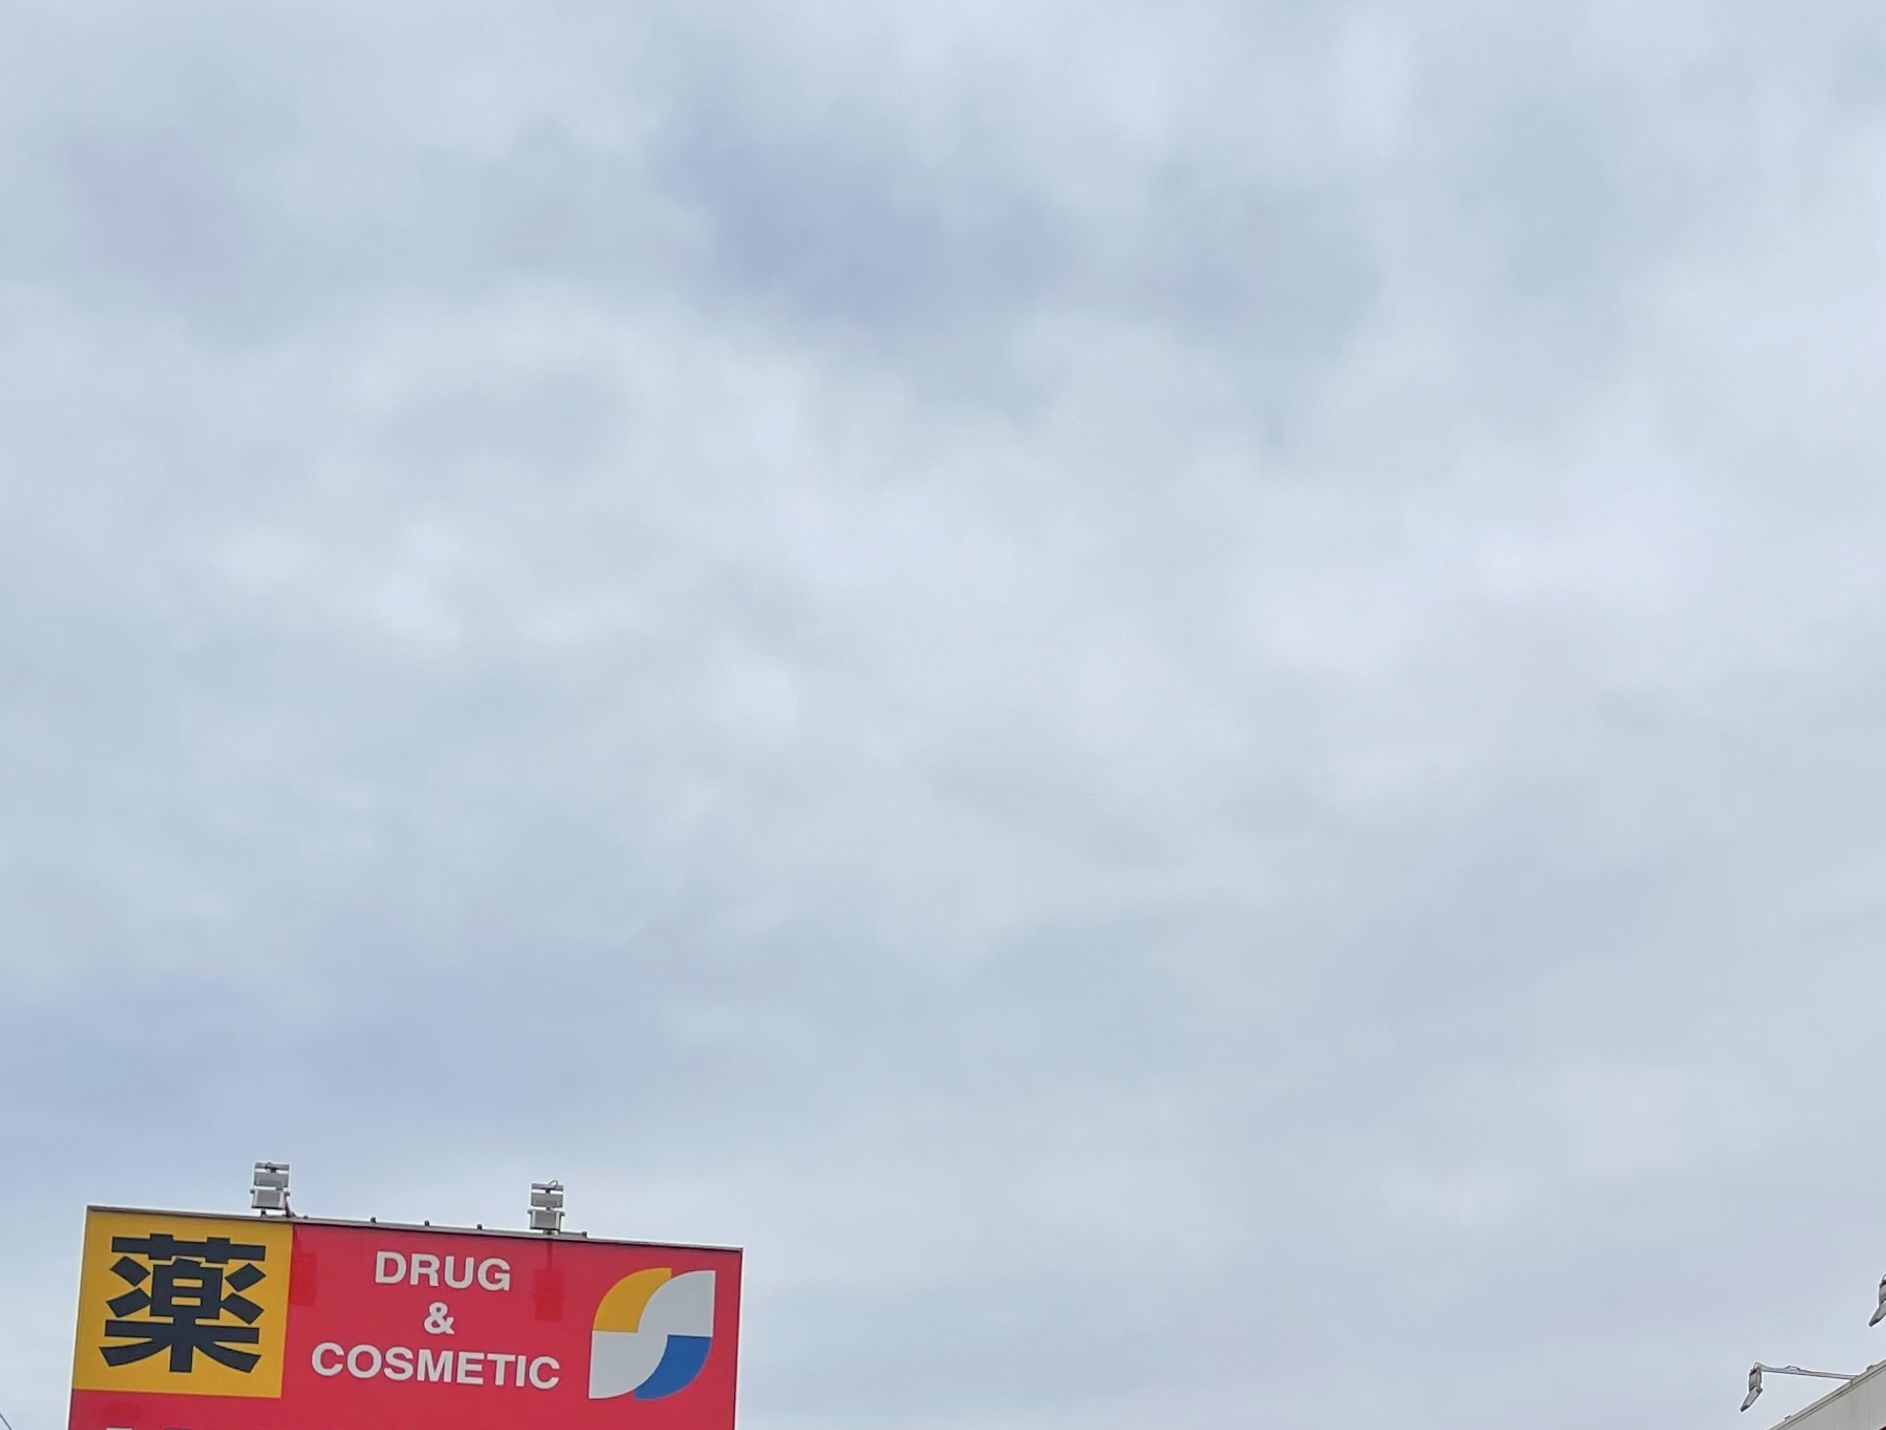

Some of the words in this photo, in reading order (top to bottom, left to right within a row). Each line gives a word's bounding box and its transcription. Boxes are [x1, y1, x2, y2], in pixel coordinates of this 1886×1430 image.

[374, 1251, 512, 1291] DRUG
[100, 1234, 267, 1373] 薬
[423, 1304, 455, 1335] &
[311, 1341, 561, 1390] COSMETIC
